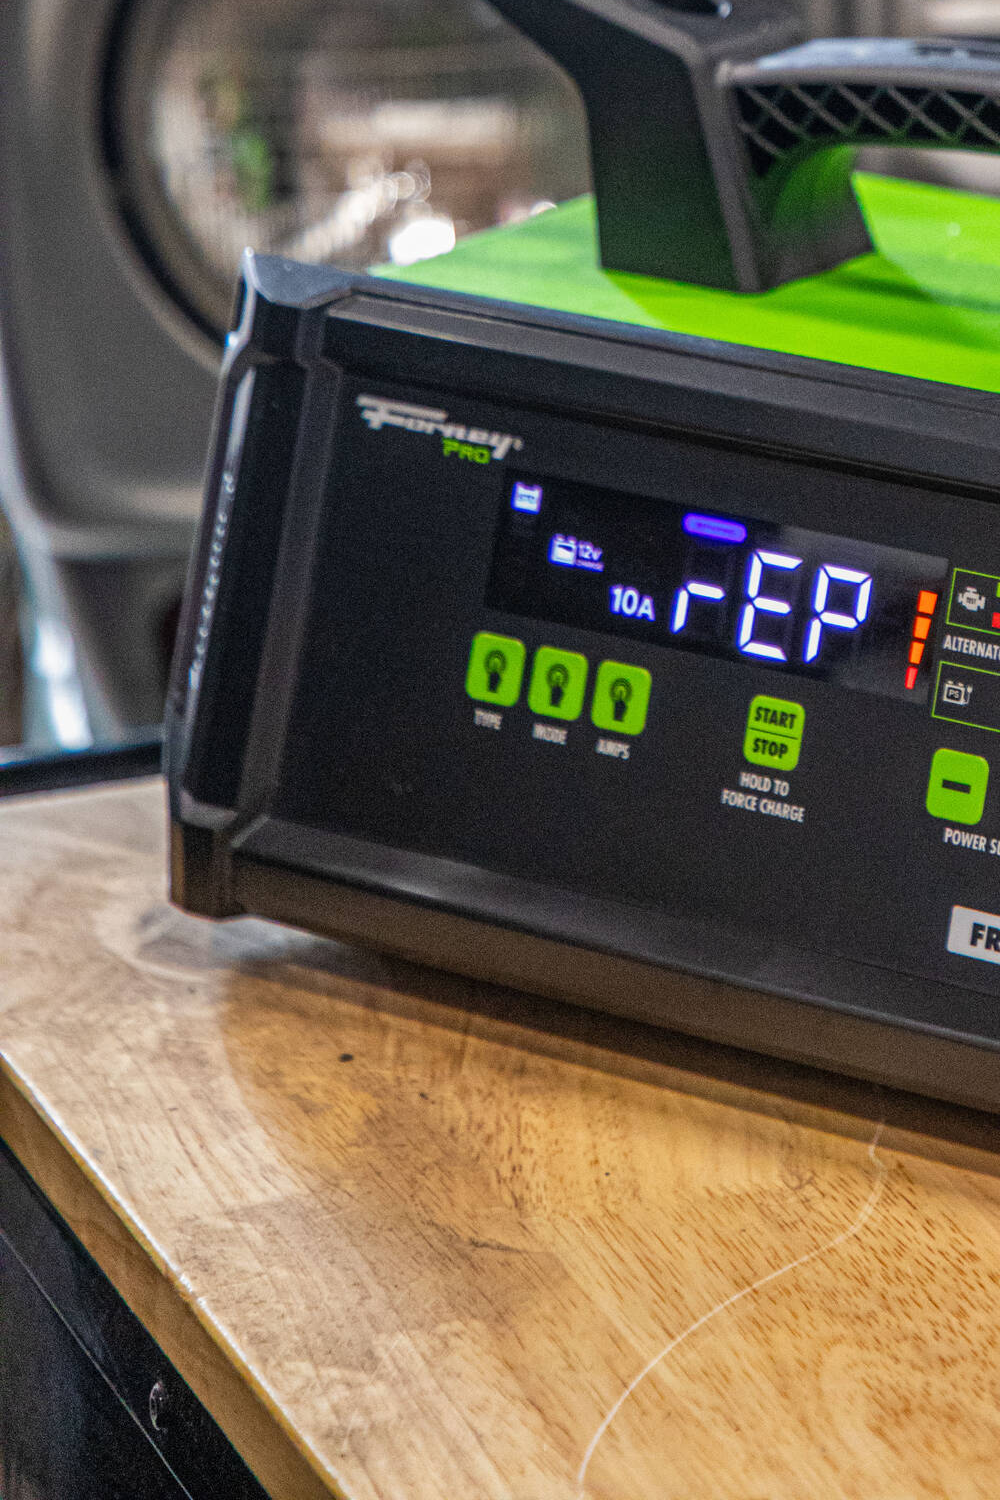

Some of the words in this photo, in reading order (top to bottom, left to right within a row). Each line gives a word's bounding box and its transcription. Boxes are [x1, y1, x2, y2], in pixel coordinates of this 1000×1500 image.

[610, 585, 656, 621] 10A
[754, 706, 797, 730] START
[752, 738, 789, 759] STOP
[740, 772, 771, 792] HOLD
[773, 778, 790, 797] TO
[721, 788, 758, 811] FORCE
[759, 798, 805, 822] CHARGE
[943, 827, 986, 852] POWER
